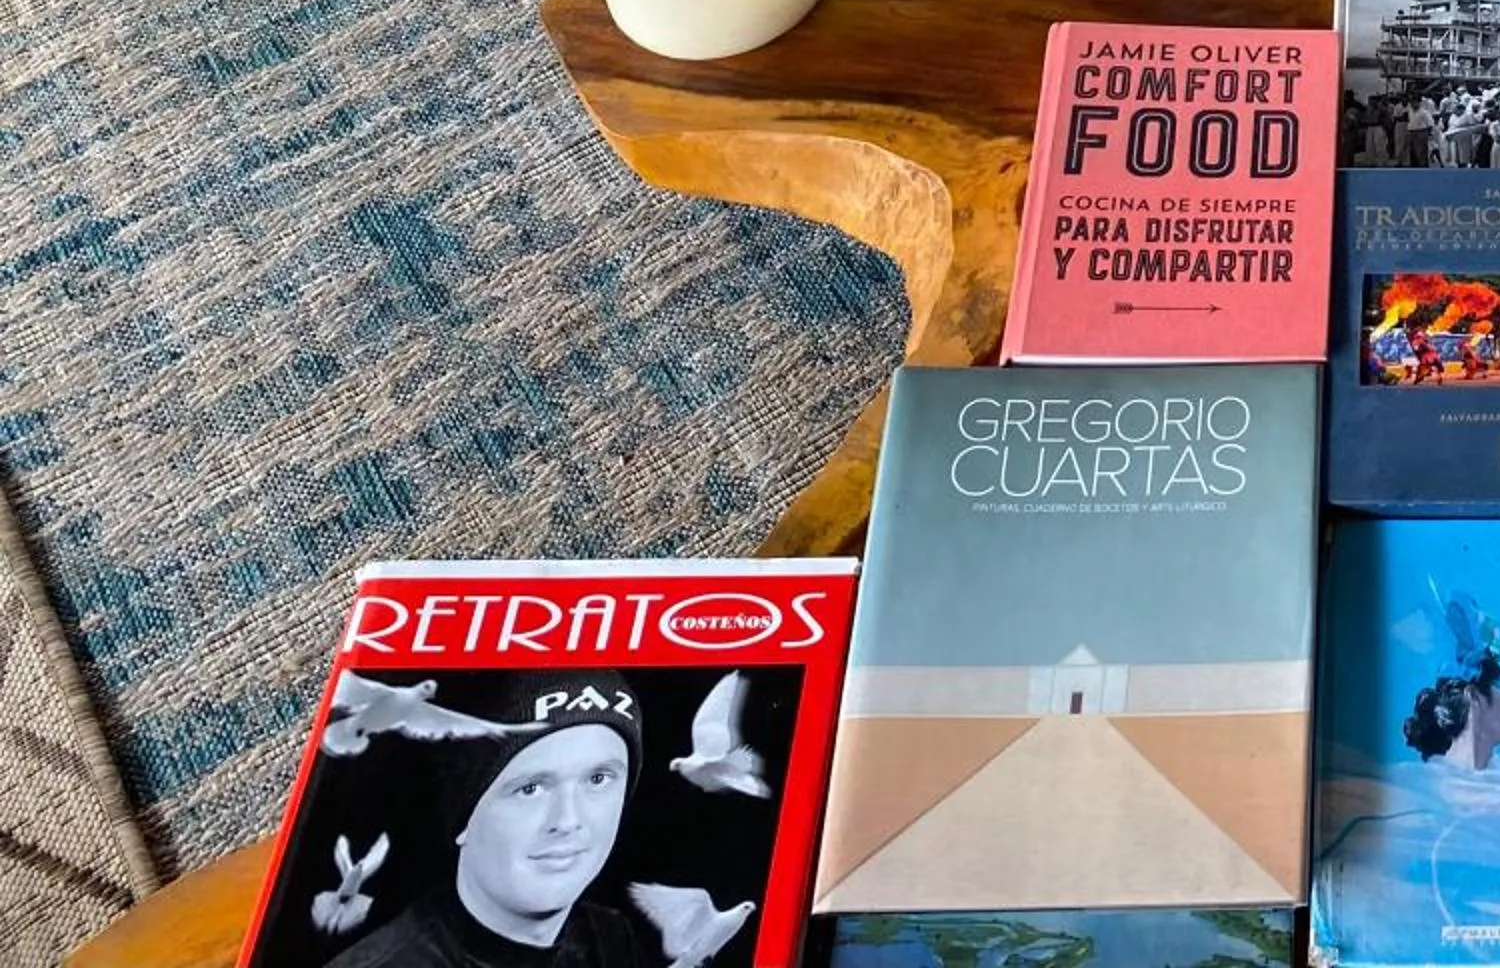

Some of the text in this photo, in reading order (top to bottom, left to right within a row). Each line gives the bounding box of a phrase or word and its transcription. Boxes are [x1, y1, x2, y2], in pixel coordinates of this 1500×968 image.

[1079, 41, 1302, 64] JAMIE OLIVER
[1073, 65, 1302, 105] COMFORT
[1063, 105, 1299, 179] FOOD
[1059, 195, 1297, 214] COCINA DE SIEMPRE
[1054, 216, 1294, 244] PARA DISFRUTAR
[1054, 248, 1294, 282] Y COMPARTIR
[958, 396, 1251, 443] GREGORIO
[951, 443, 1247, 497] CUARTAS
[342, 592, 827, 653] RETRATOS
[669, 612, 773, 630] COSTEÑOS
[534, 686, 636, 721] PAZ
